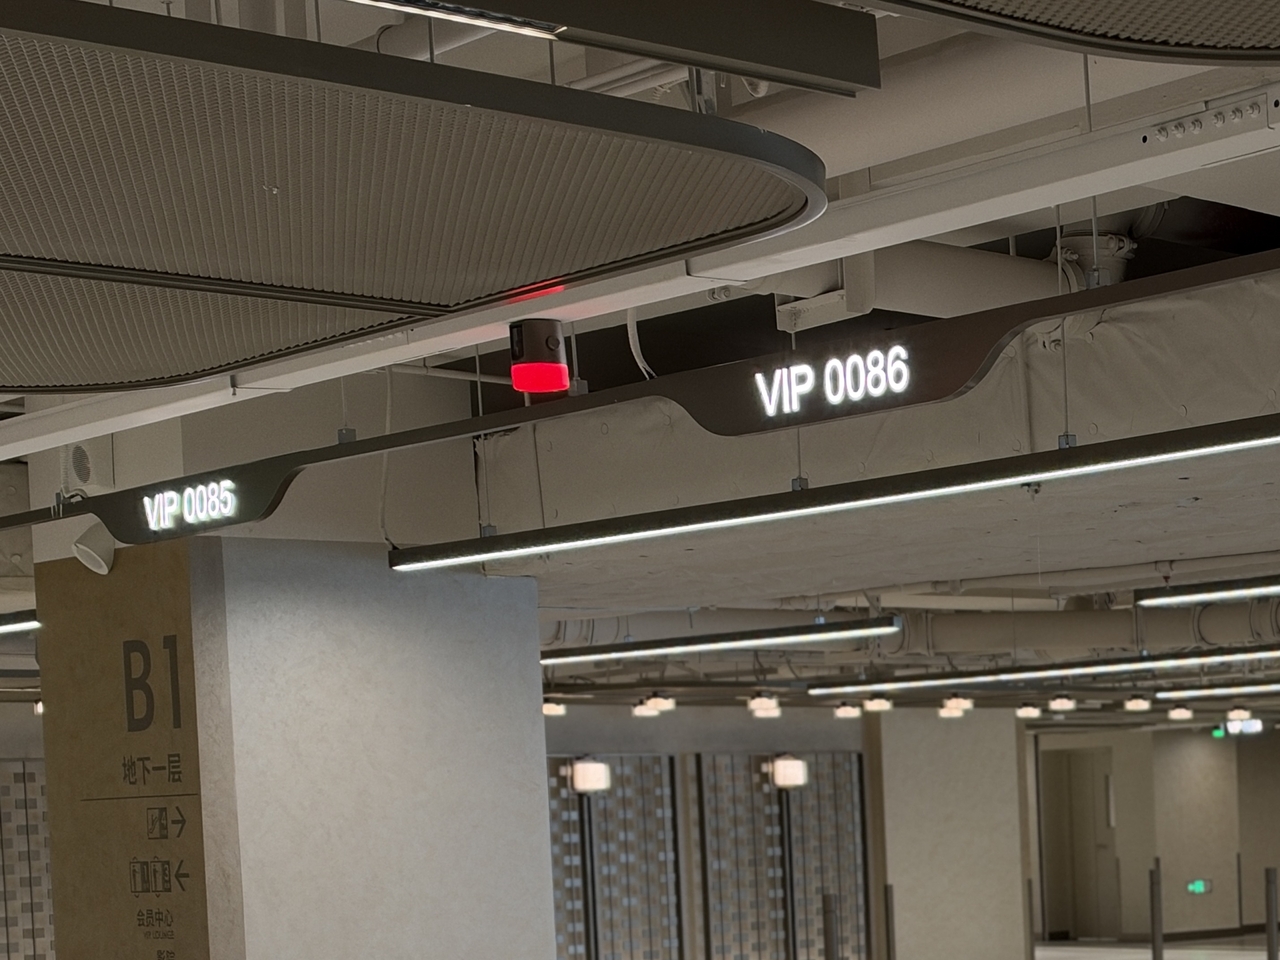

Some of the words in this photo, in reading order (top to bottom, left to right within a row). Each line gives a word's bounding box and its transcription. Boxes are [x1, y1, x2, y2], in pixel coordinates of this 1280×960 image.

[755, 363, 815, 417] VIP
[824, 345, 909, 405] 0086
[143, 490, 180, 530] VIP
[183, 479, 236, 524] 0085
[122, 634, 182, 733] B1
[122, 753, 182, 785] 地下一层
[136, 908, 174, 928] 会员中心
